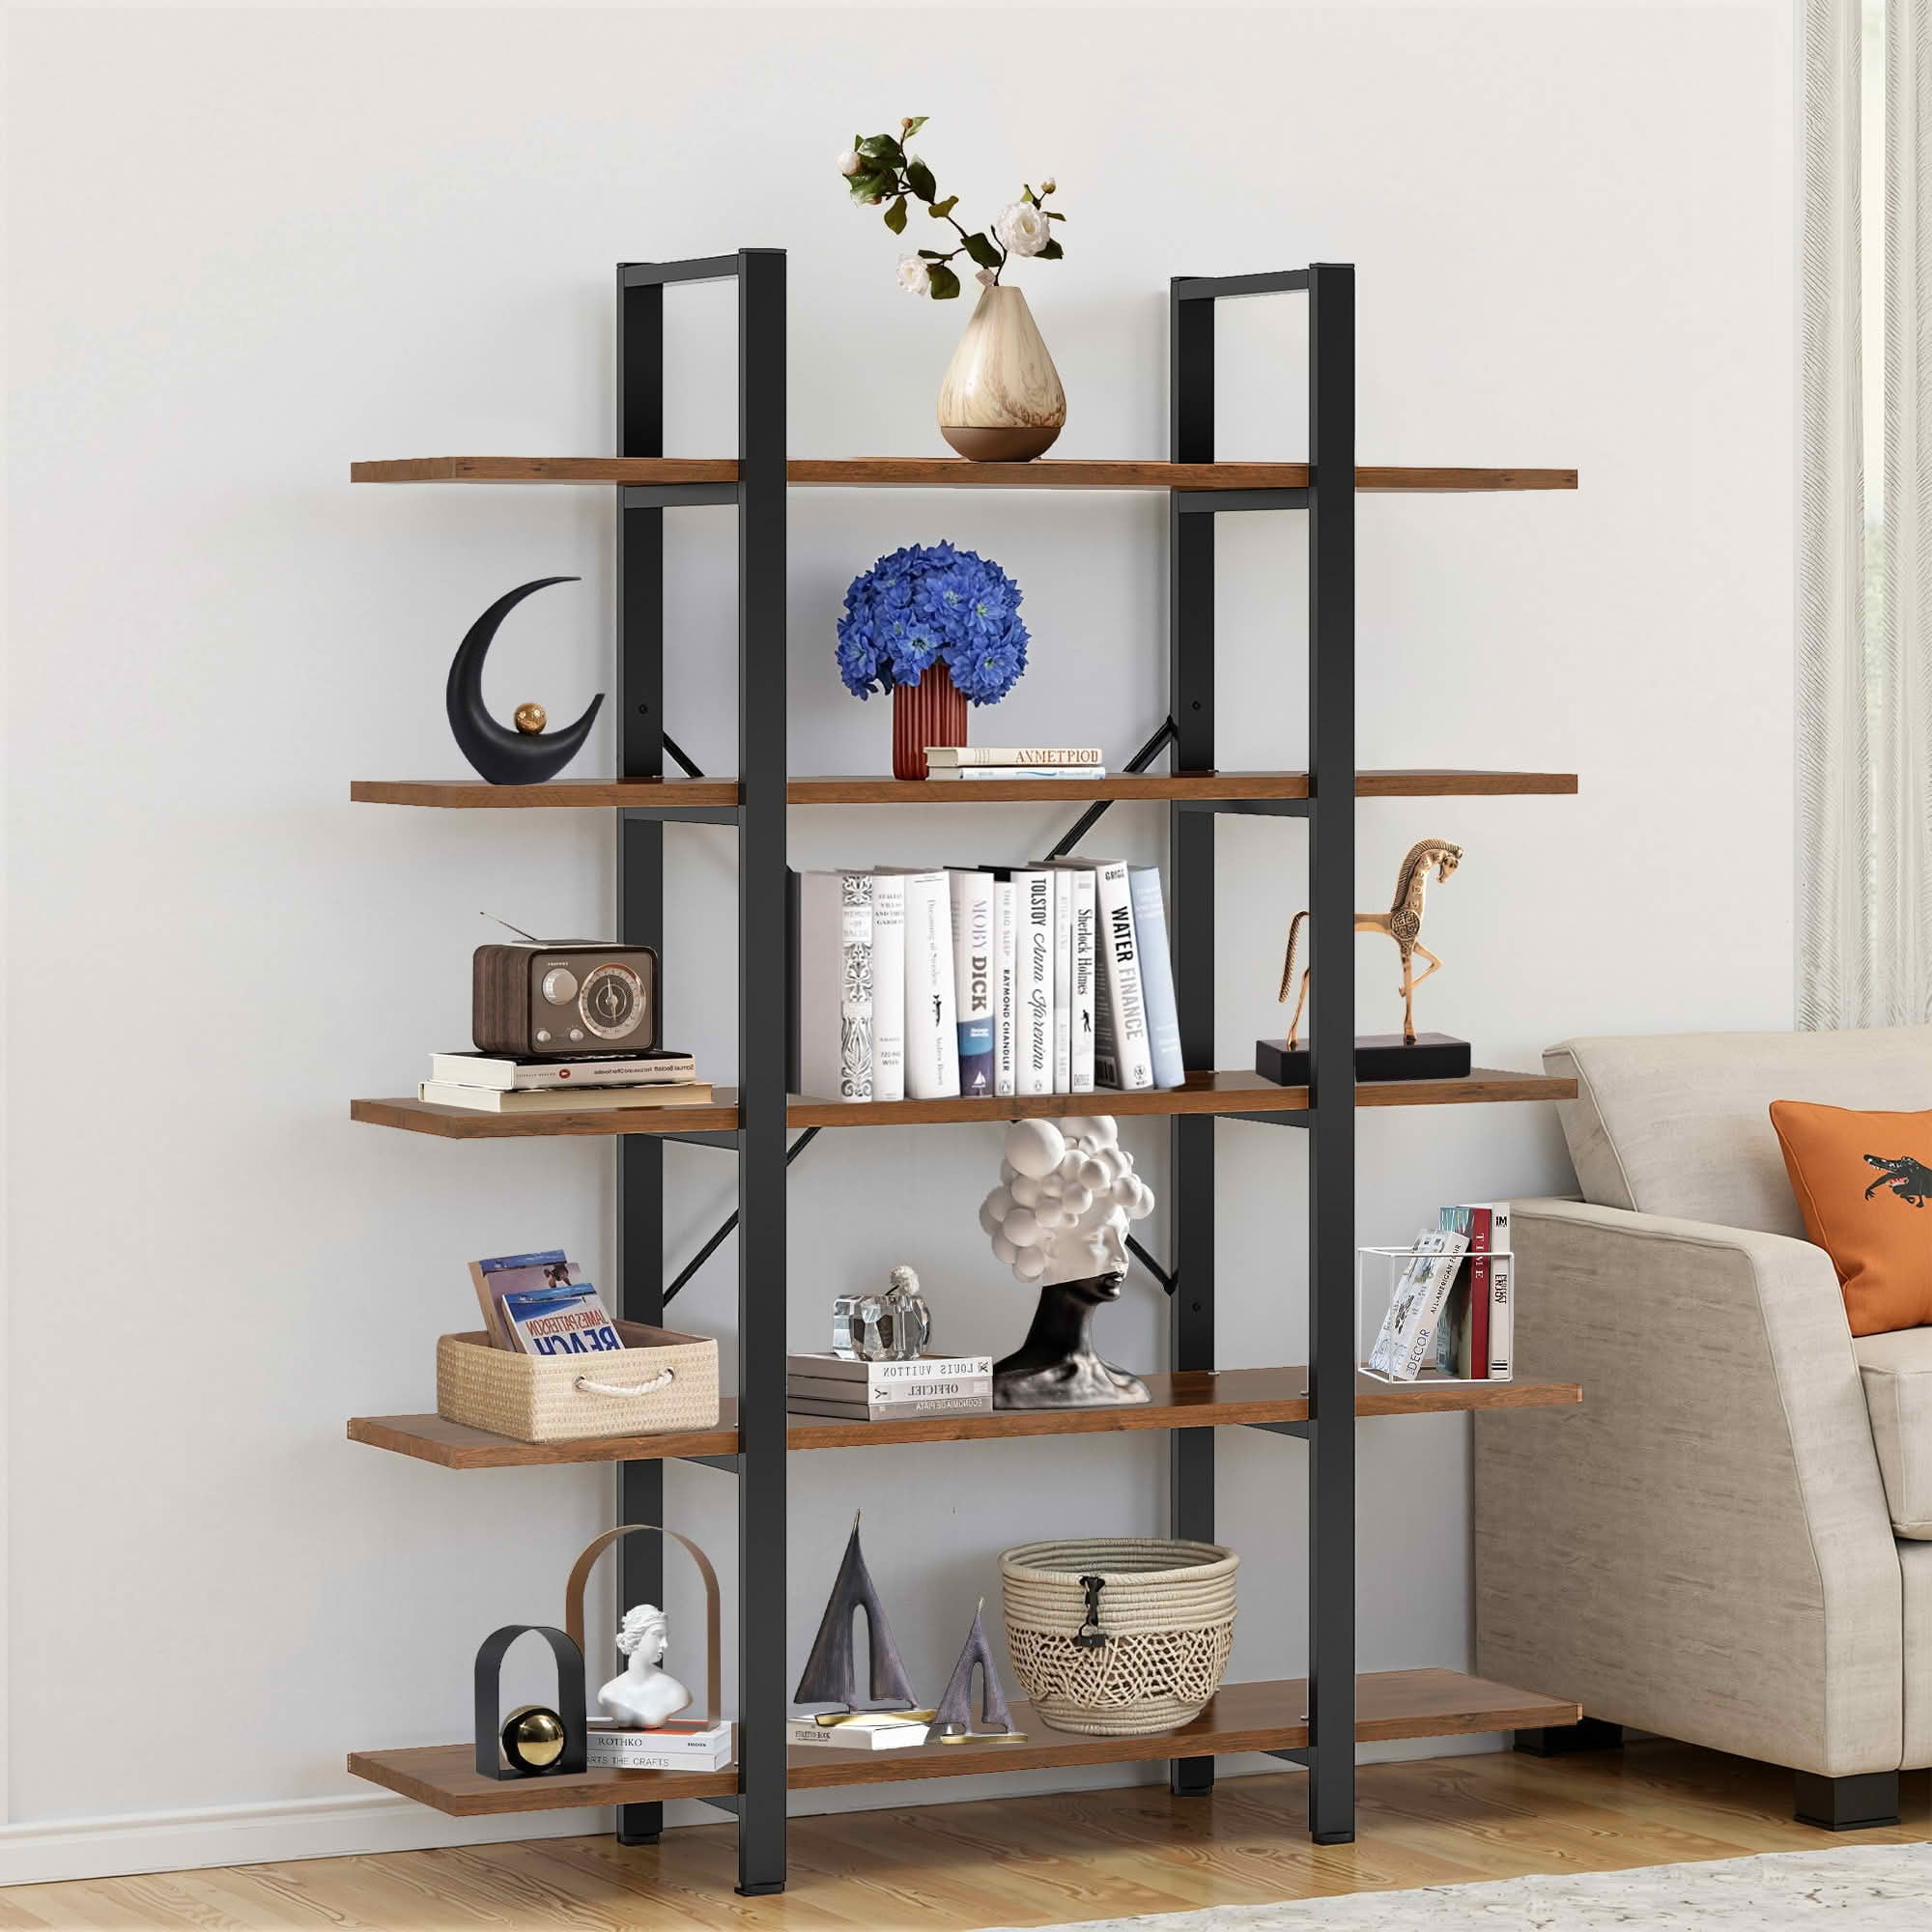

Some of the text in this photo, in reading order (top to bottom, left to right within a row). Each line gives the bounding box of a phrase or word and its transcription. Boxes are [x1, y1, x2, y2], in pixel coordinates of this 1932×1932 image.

[973, 900, 987, 951] MOBY
[1032, 878, 1046, 926] TOLSTOY
[1077, 908, 1093, 995] Sherlock Holmes
[1111, 906, 1144, 1041] WATER FINANCE
[972, 956, 987, 1011] DICK
[1028, 933, 1047, 1070] Anna Karenina
[598, 1738, 642, 1747] ROTHKO
[611, 1756, 629, 1765] THE
[634, 1757, 669, 1767] CRAFTS
